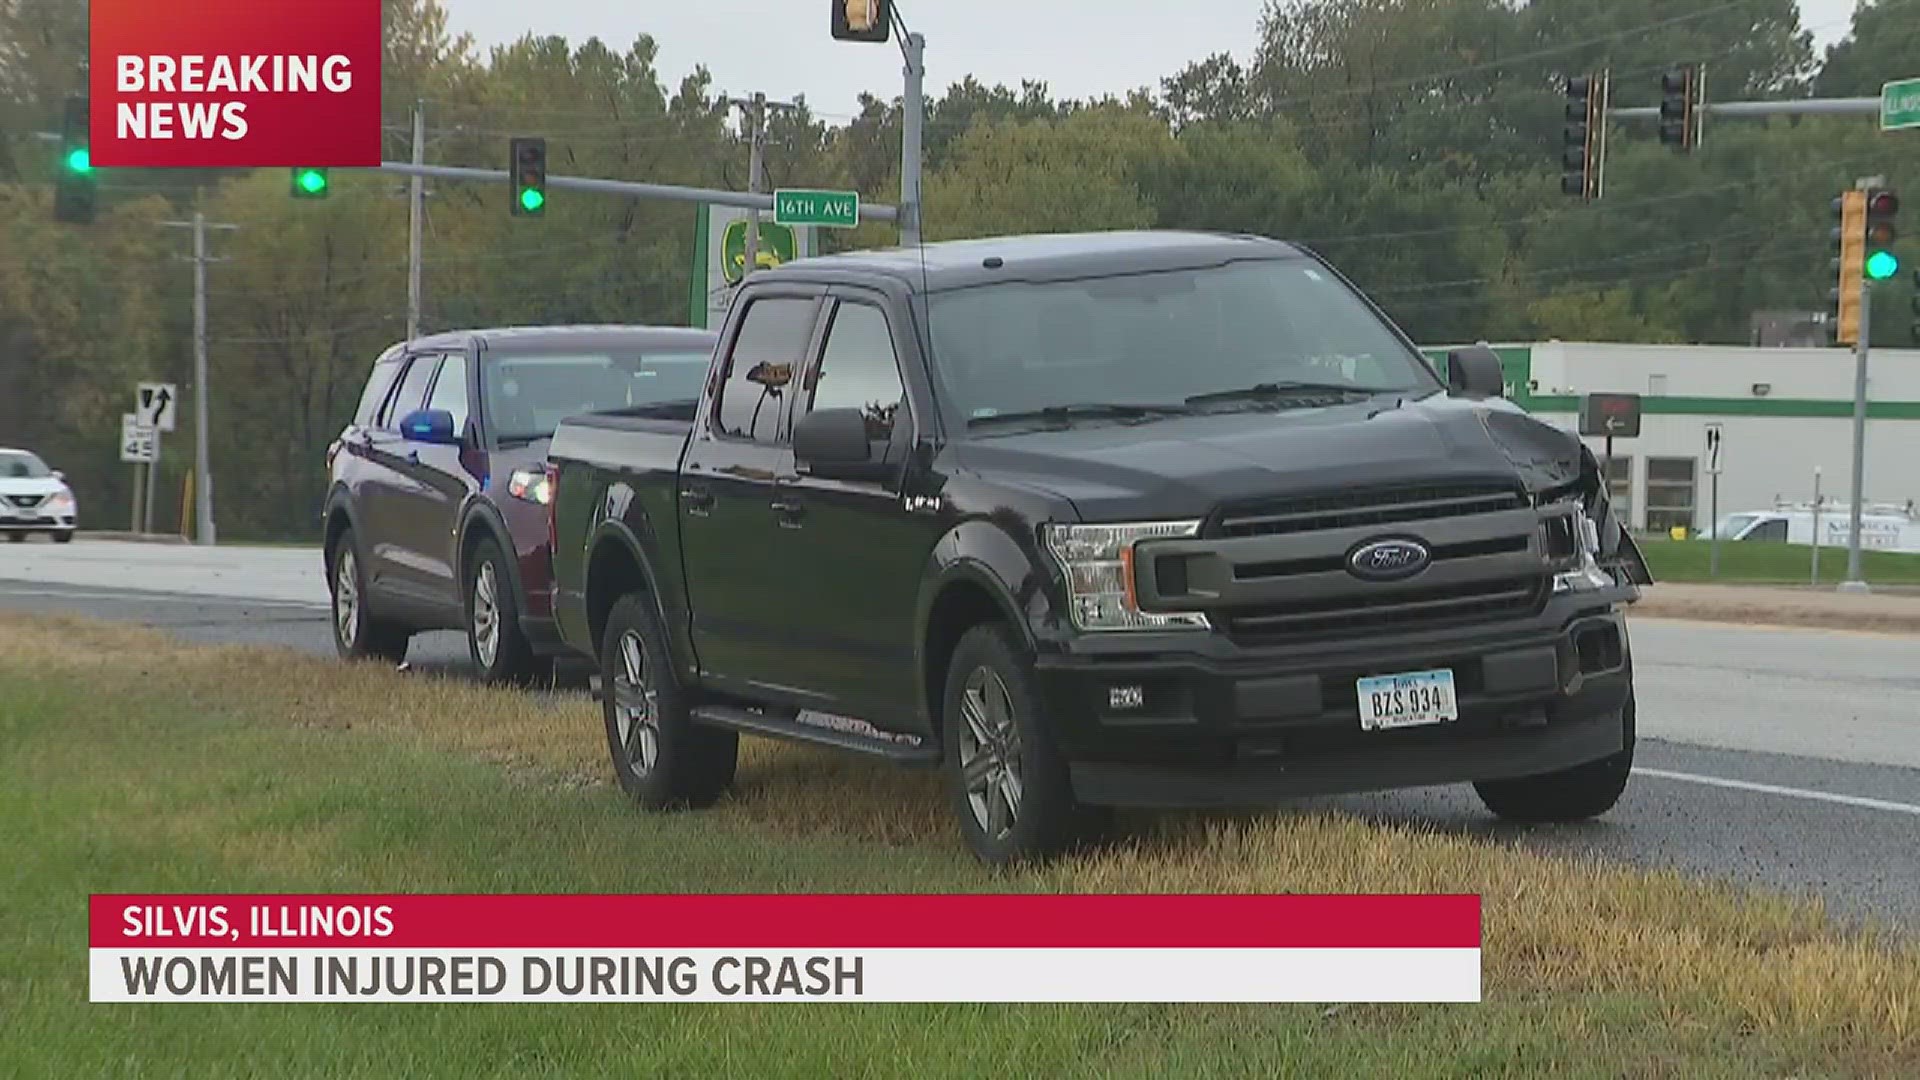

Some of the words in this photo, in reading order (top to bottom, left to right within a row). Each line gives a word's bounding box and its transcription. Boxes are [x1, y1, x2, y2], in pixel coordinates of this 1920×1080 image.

[780, 199, 815, 216] 16TH
[823, 201, 852, 217] AVE
[1371, 547, 1410, 569] Ford
[1371, 689, 1404, 717] BZS
[1409, 686, 1441, 714] 934
